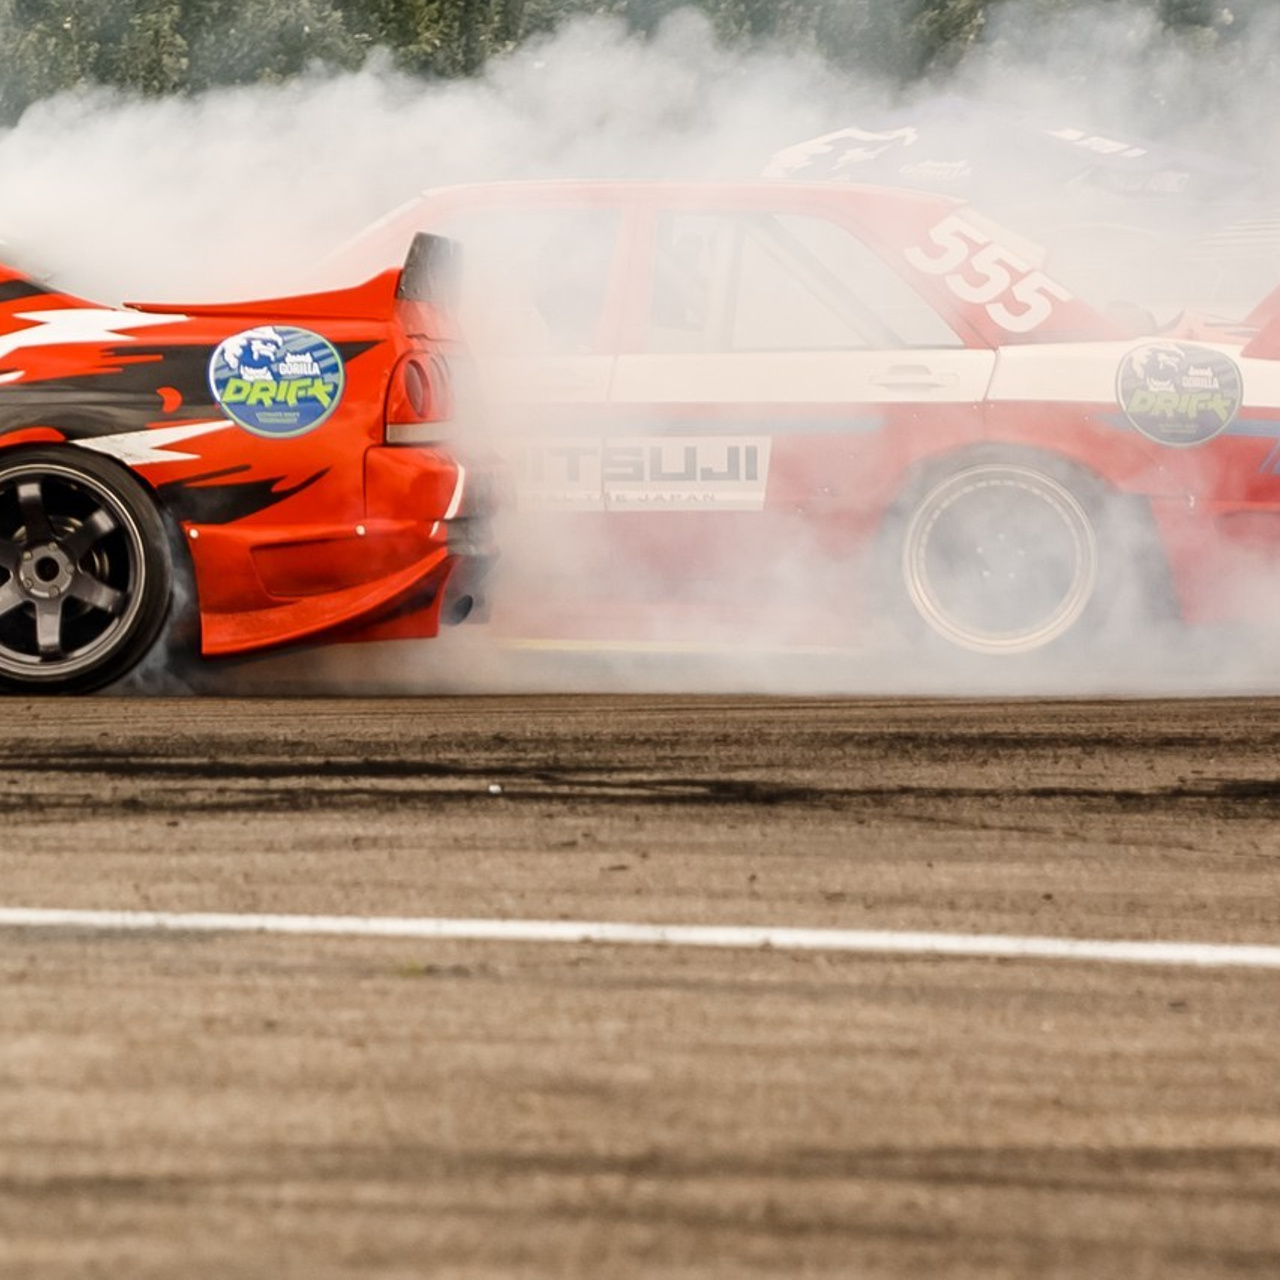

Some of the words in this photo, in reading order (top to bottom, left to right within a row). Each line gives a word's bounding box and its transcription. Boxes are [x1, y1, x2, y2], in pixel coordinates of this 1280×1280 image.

[903, 214, 1074, 332] 555
[279, 361, 320, 376] GORILLA
[1182, 375, 1219, 389] GORILLA
[518, 445, 758, 482] ITSUJI
